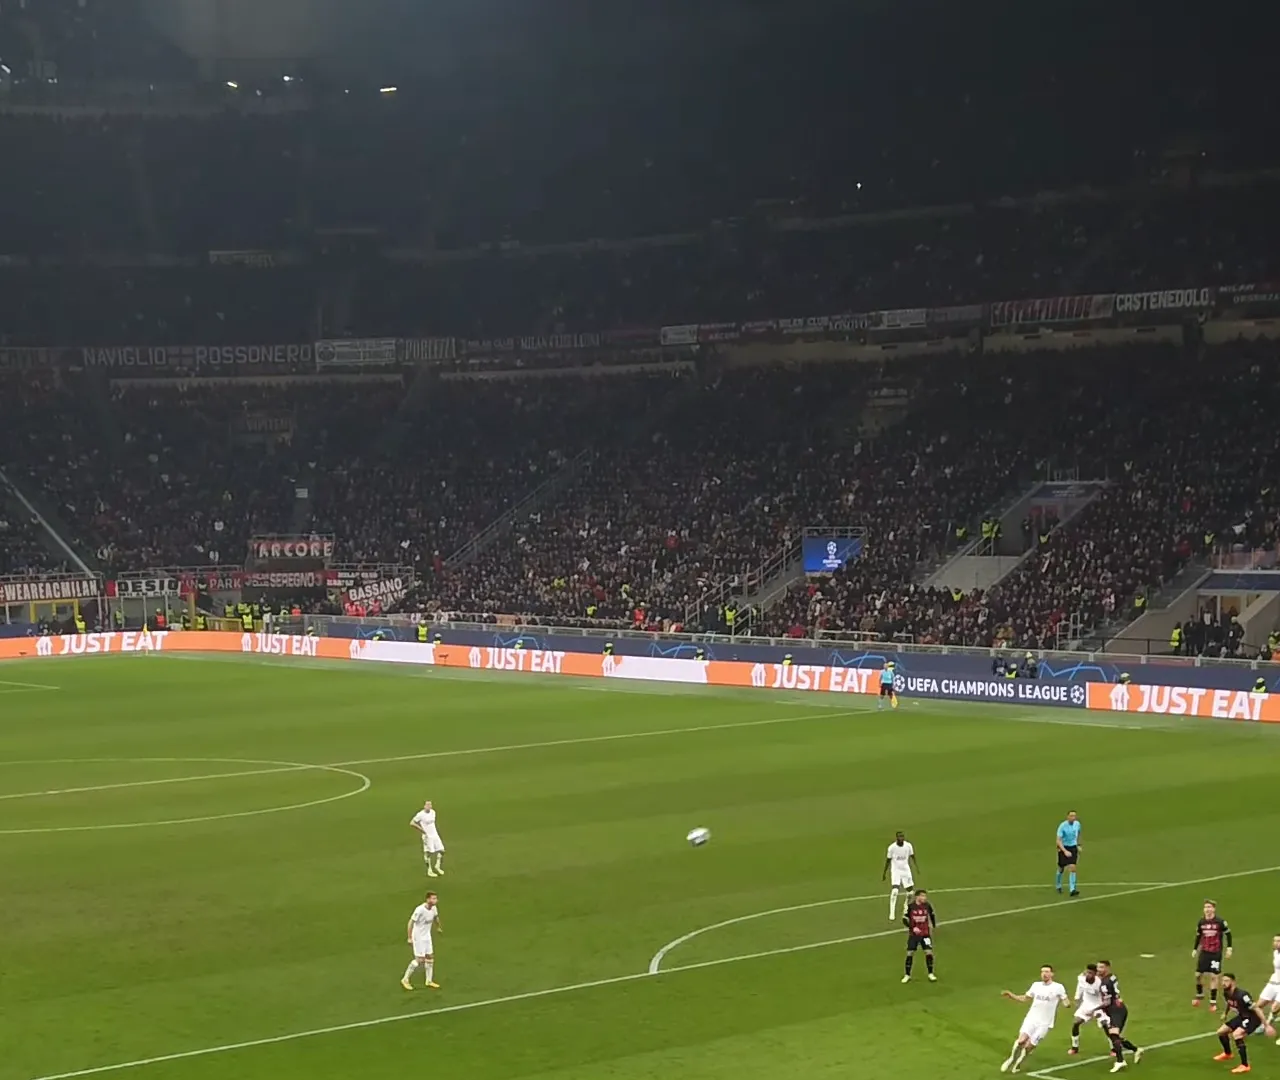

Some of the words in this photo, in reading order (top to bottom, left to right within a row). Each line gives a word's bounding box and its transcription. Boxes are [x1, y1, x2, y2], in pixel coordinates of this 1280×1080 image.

[83, 346, 166, 367] NAVIGLIO
[196, 345, 312, 365] ROSSONERO
[259, 541, 332, 558] ARCORE
[118, 580, 179, 592] DESIO
[209, 578, 241, 590] PARK
[348, 577, 403, 601] BASSANO
[59, 633, 116, 655] JUST
[121, 631, 168, 652] EAT
[255, 633, 290, 655] JUST
[292, 635, 320, 657] EAT
[485, 646, 529, 671] JUST
[531, 650, 565, 674] EAT
[772, 664, 826, 690] JUST
[828, 667, 873, 694] EAT
[907, 676, 938, 693] UEFA
[941, 678, 1015, 699] CHAMPIONS
[1018, 683, 1068, 701] LEAGUE
[1137, 684, 1207, 716] JUST
[1212, 689, 1269, 720] EAT
